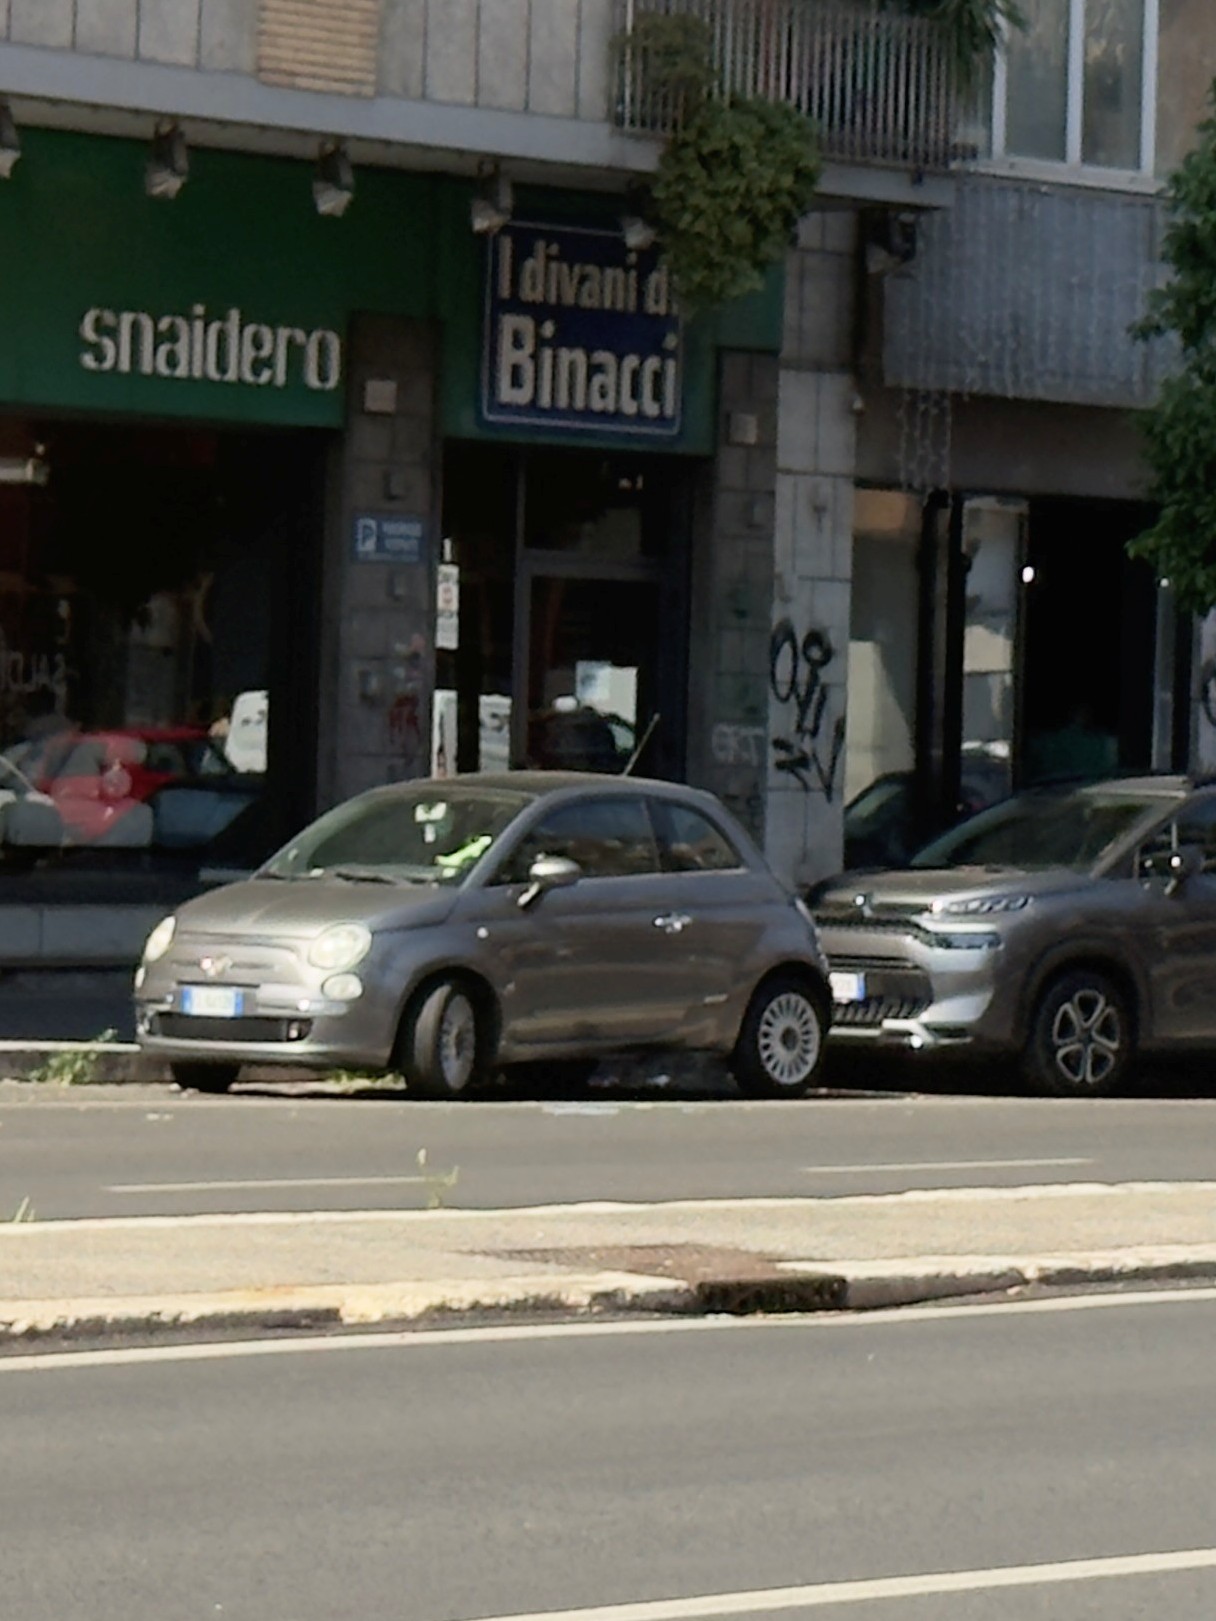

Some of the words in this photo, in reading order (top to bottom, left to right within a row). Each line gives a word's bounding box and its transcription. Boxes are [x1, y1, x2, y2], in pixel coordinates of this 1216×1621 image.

[498, 235, 513, 299] I
[518, 239, 638, 313] divani
[79, 303, 342, 390] snaidero
[496, 313, 678, 419] Binacci
